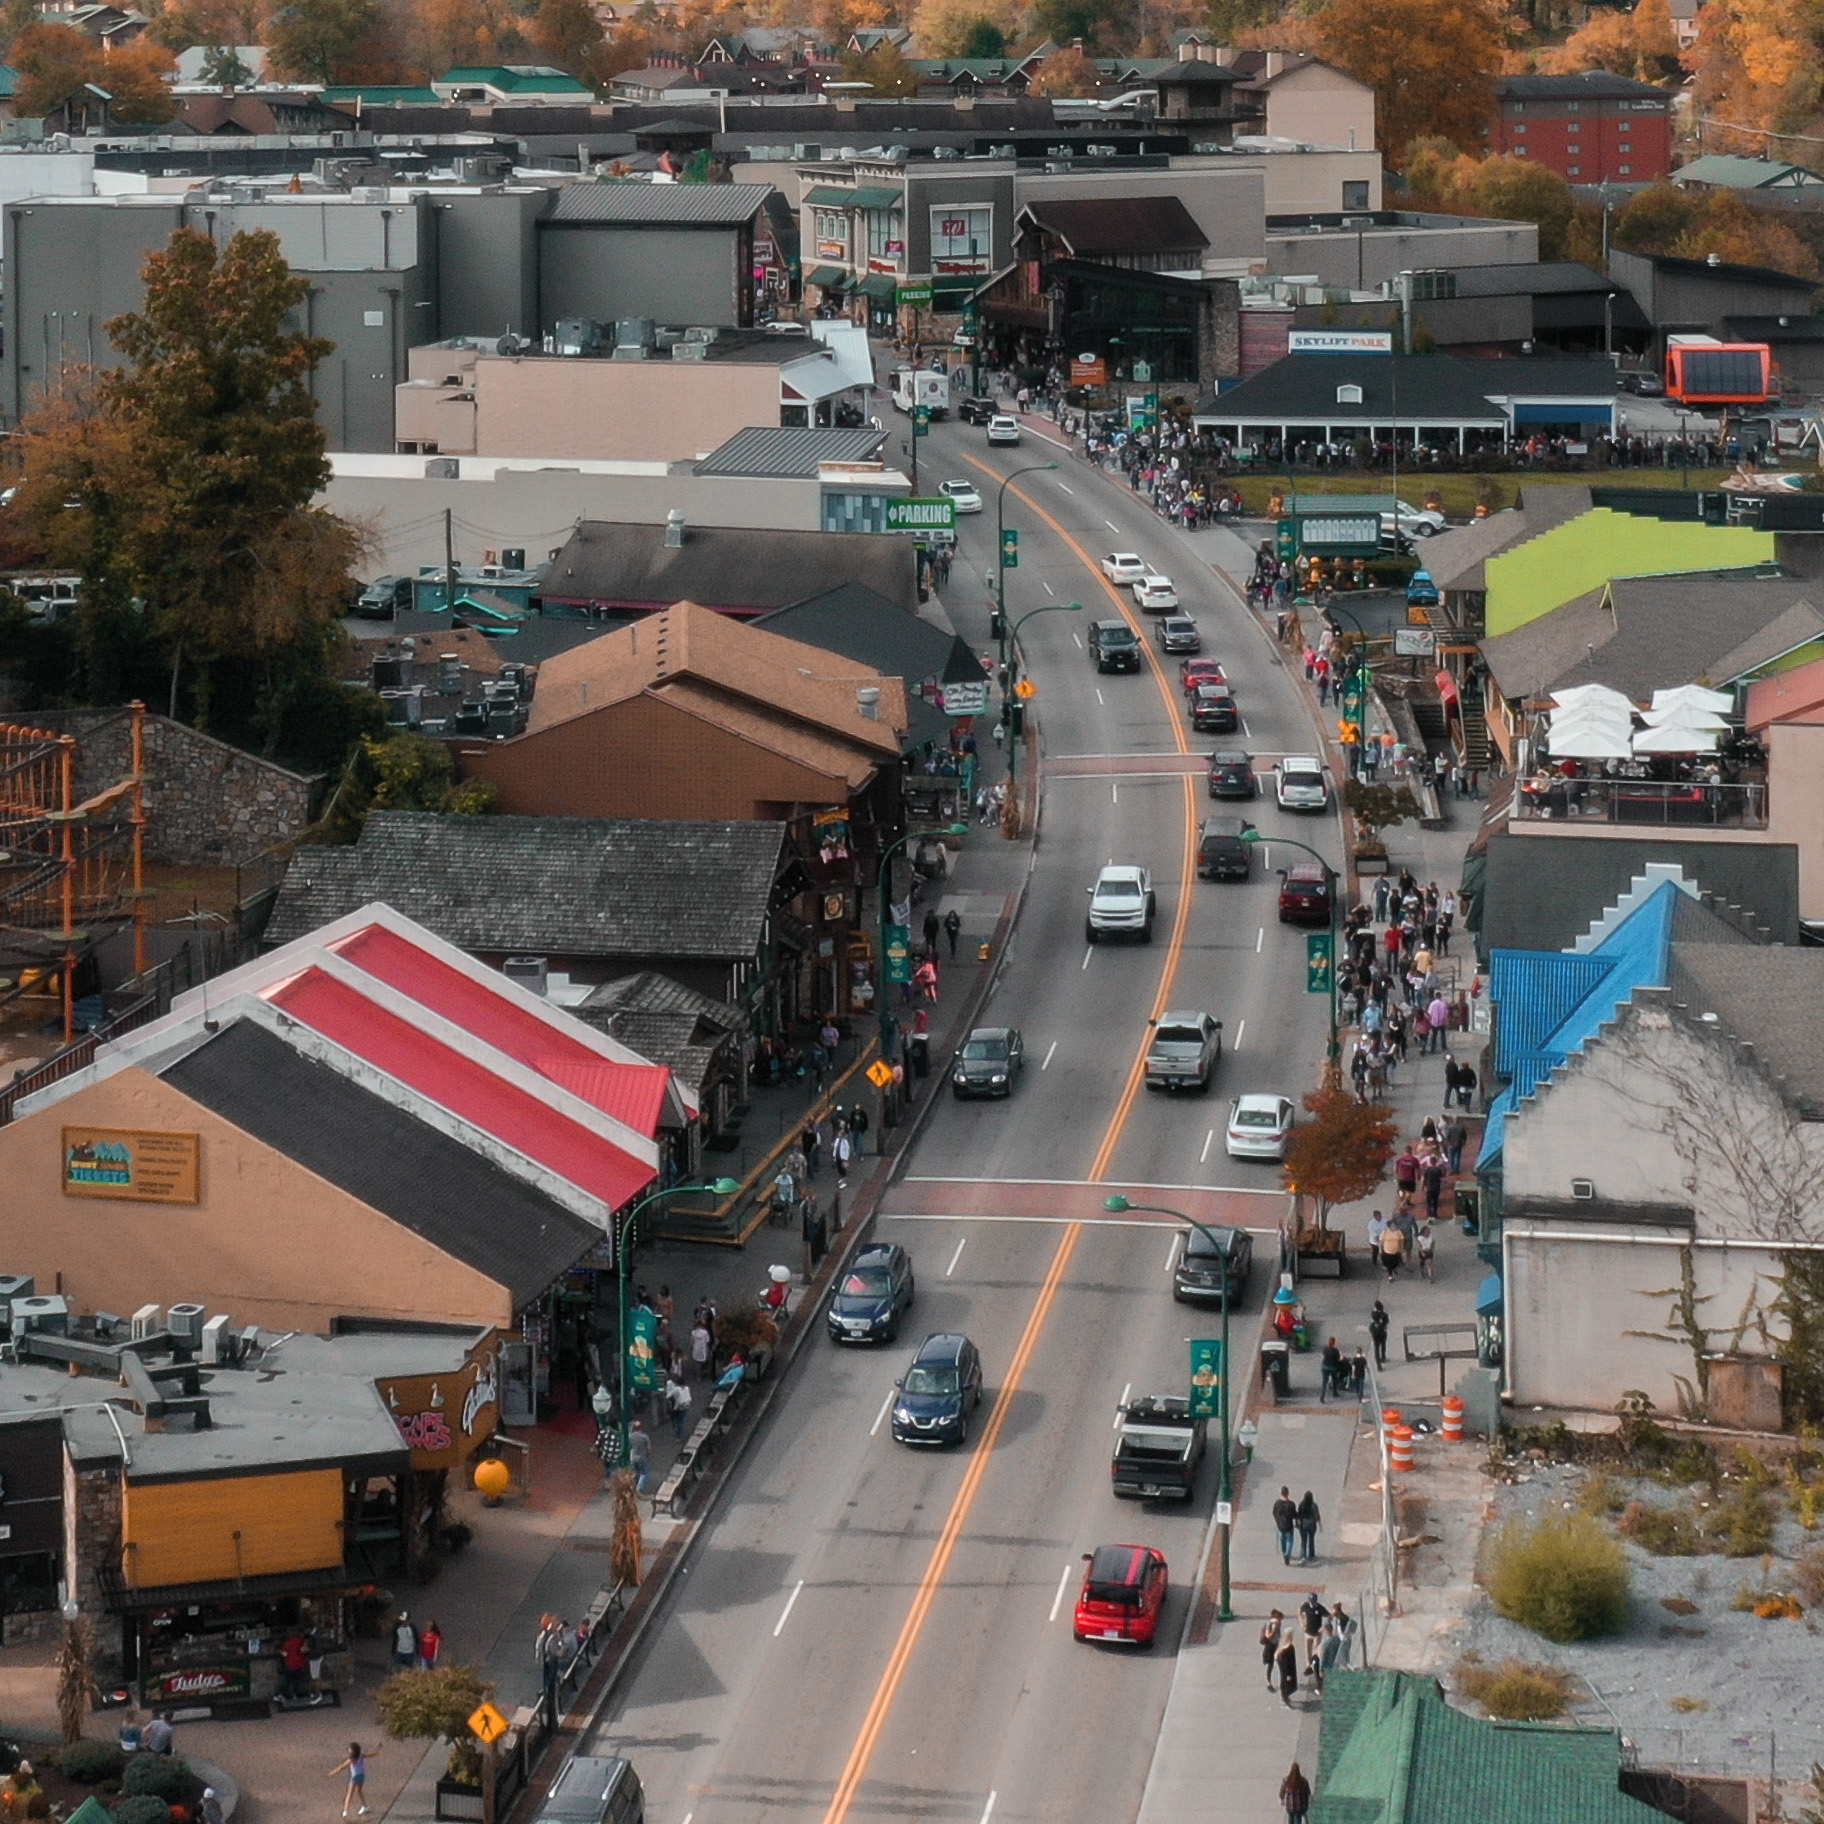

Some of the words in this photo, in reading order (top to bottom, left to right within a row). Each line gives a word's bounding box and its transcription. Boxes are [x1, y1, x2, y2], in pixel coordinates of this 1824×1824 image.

[1295, 337, 1350, 347] SKYLIFT
[1351, 338, 1386, 348] PARK
[898, 504, 951, 524] PARKING
[170, 1673, 226, 1693] Fudge
